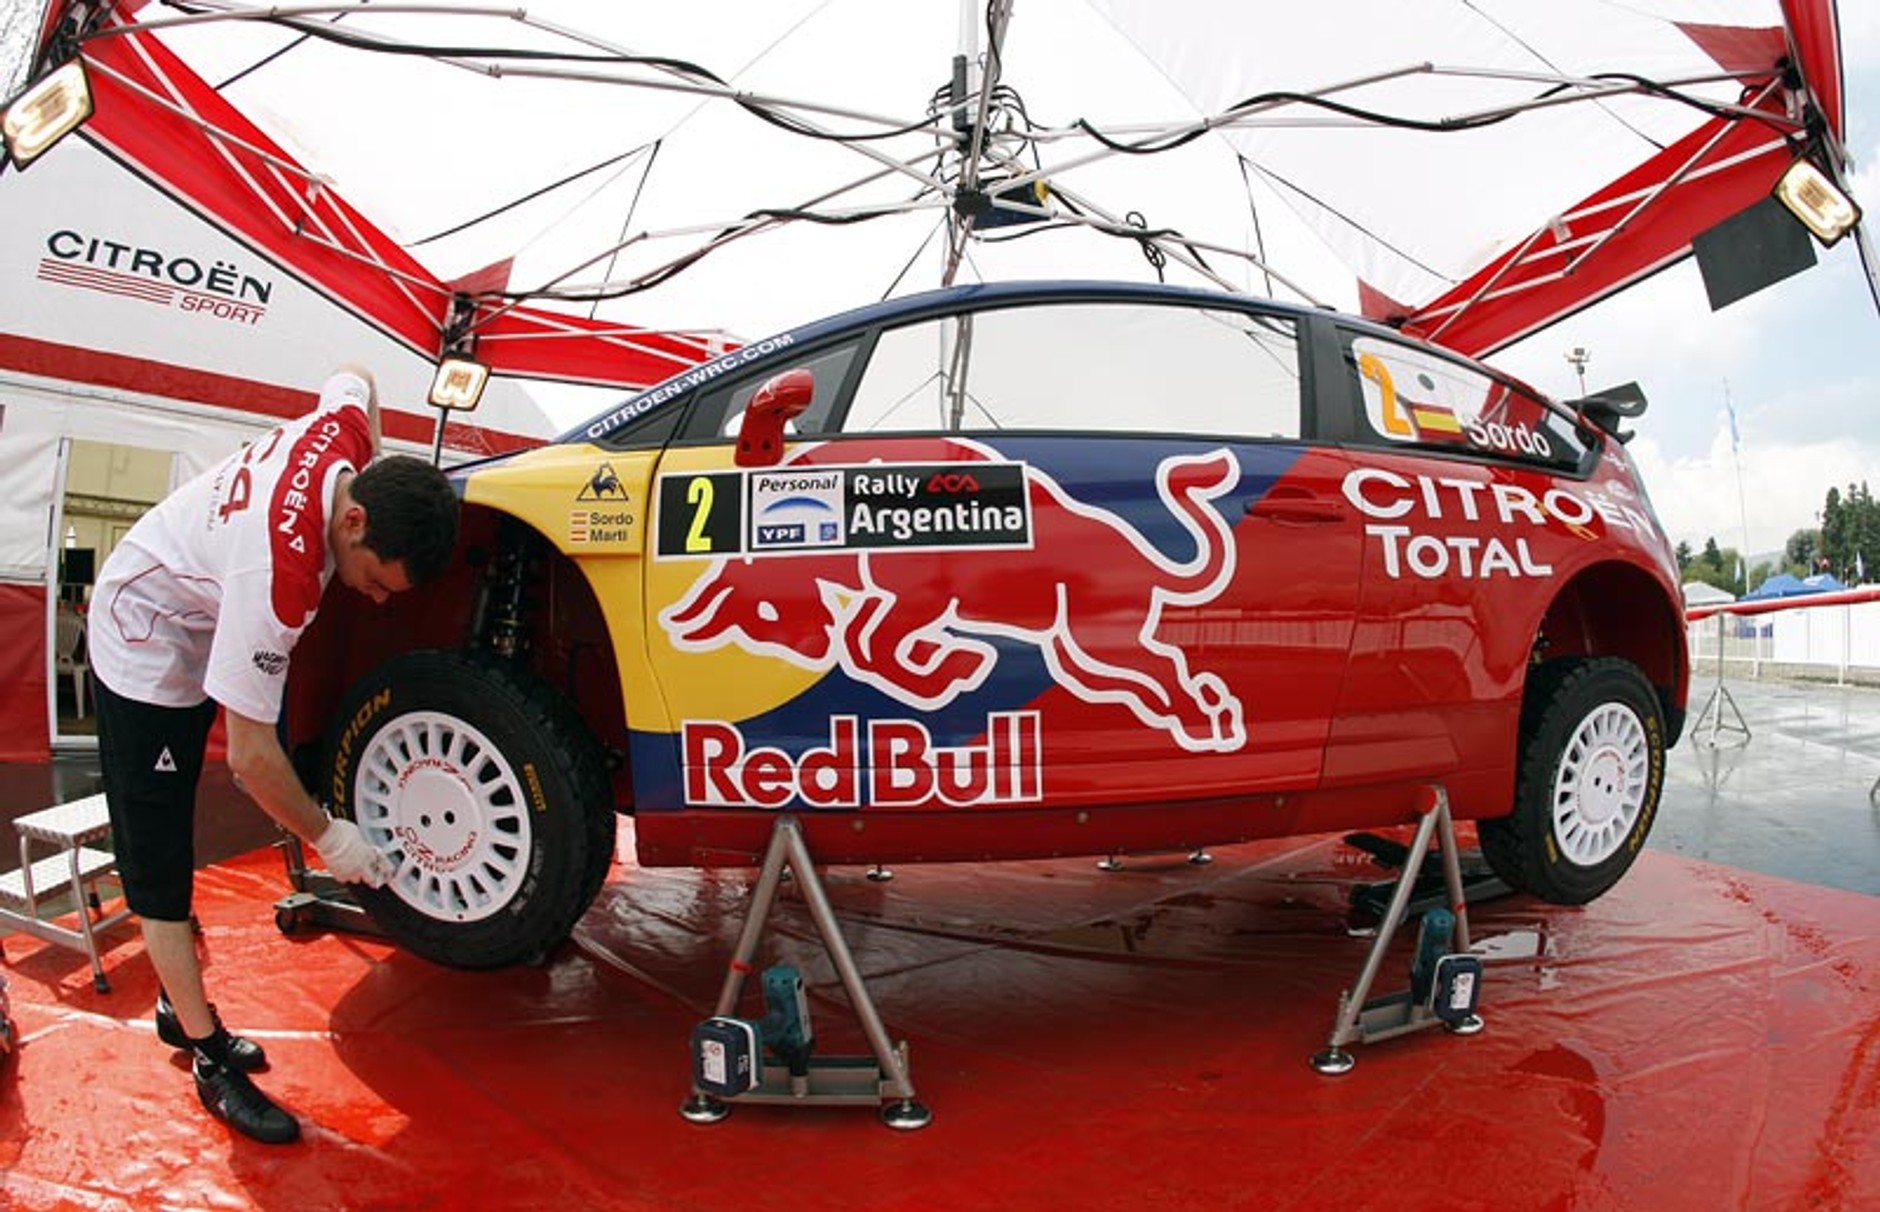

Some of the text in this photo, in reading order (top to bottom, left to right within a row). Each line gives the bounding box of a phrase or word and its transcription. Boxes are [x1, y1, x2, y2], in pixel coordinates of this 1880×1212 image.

[47, 230, 272, 304] CITROËN
[180, 296, 264, 325] SPORT
[1359, 353, 1411, 434] 2
[1468, 414, 1551, 457] Sordo
[758, 475, 838, 492] Personal
[854, 474, 920, 498] Rally
[1341, 468, 1657, 542] CITROËN
[590, 512, 633, 525] Sordo
[686, 477, 714, 552] 2
[762, 528, 798, 540] YPF
[850, 500, 1024, 539] Argentina
[1365, 525, 1553, 578] TOTAL
[333, 688, 391, 820] CORPION
[681, 710, 1042, 808] Red Bull
